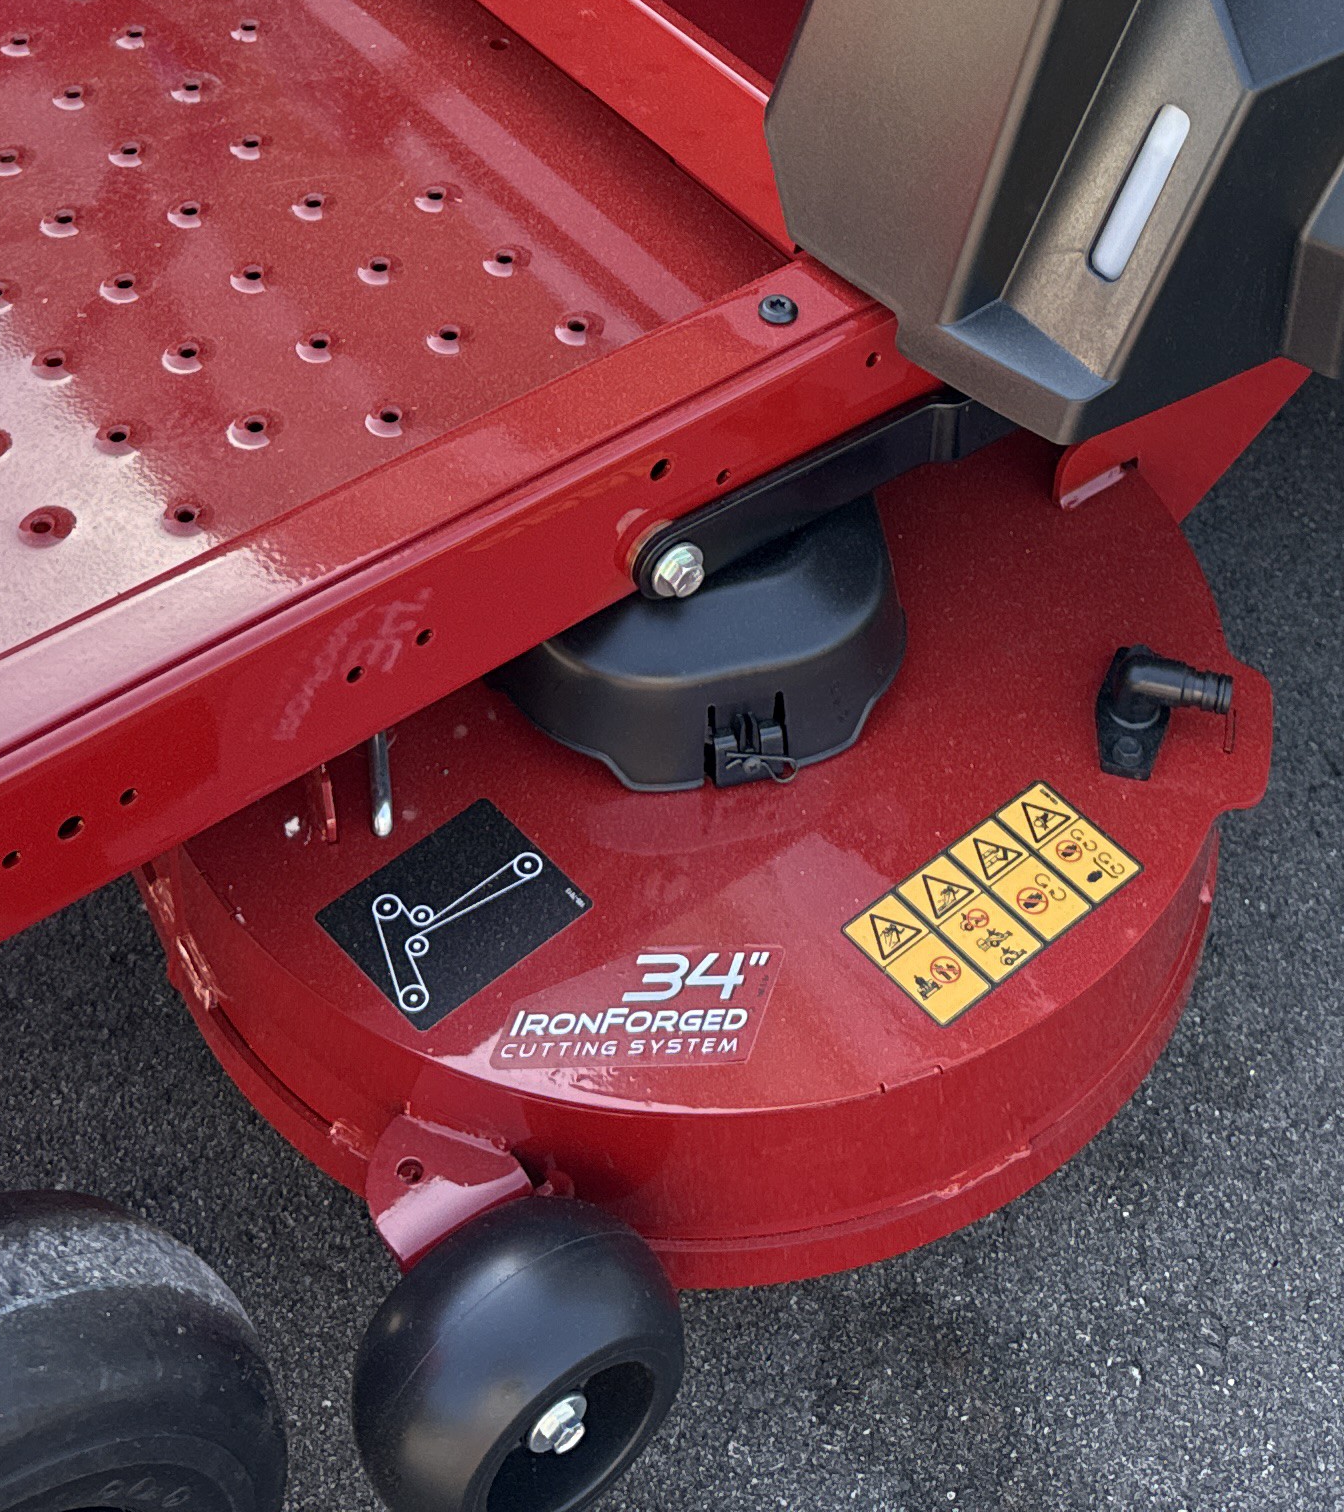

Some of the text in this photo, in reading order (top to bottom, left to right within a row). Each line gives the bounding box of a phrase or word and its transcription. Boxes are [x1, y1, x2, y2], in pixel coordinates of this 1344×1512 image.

[622, 951, 770, 1002] 34"
[500, 1037, 739, 1059] CUTTING SYSTEM
